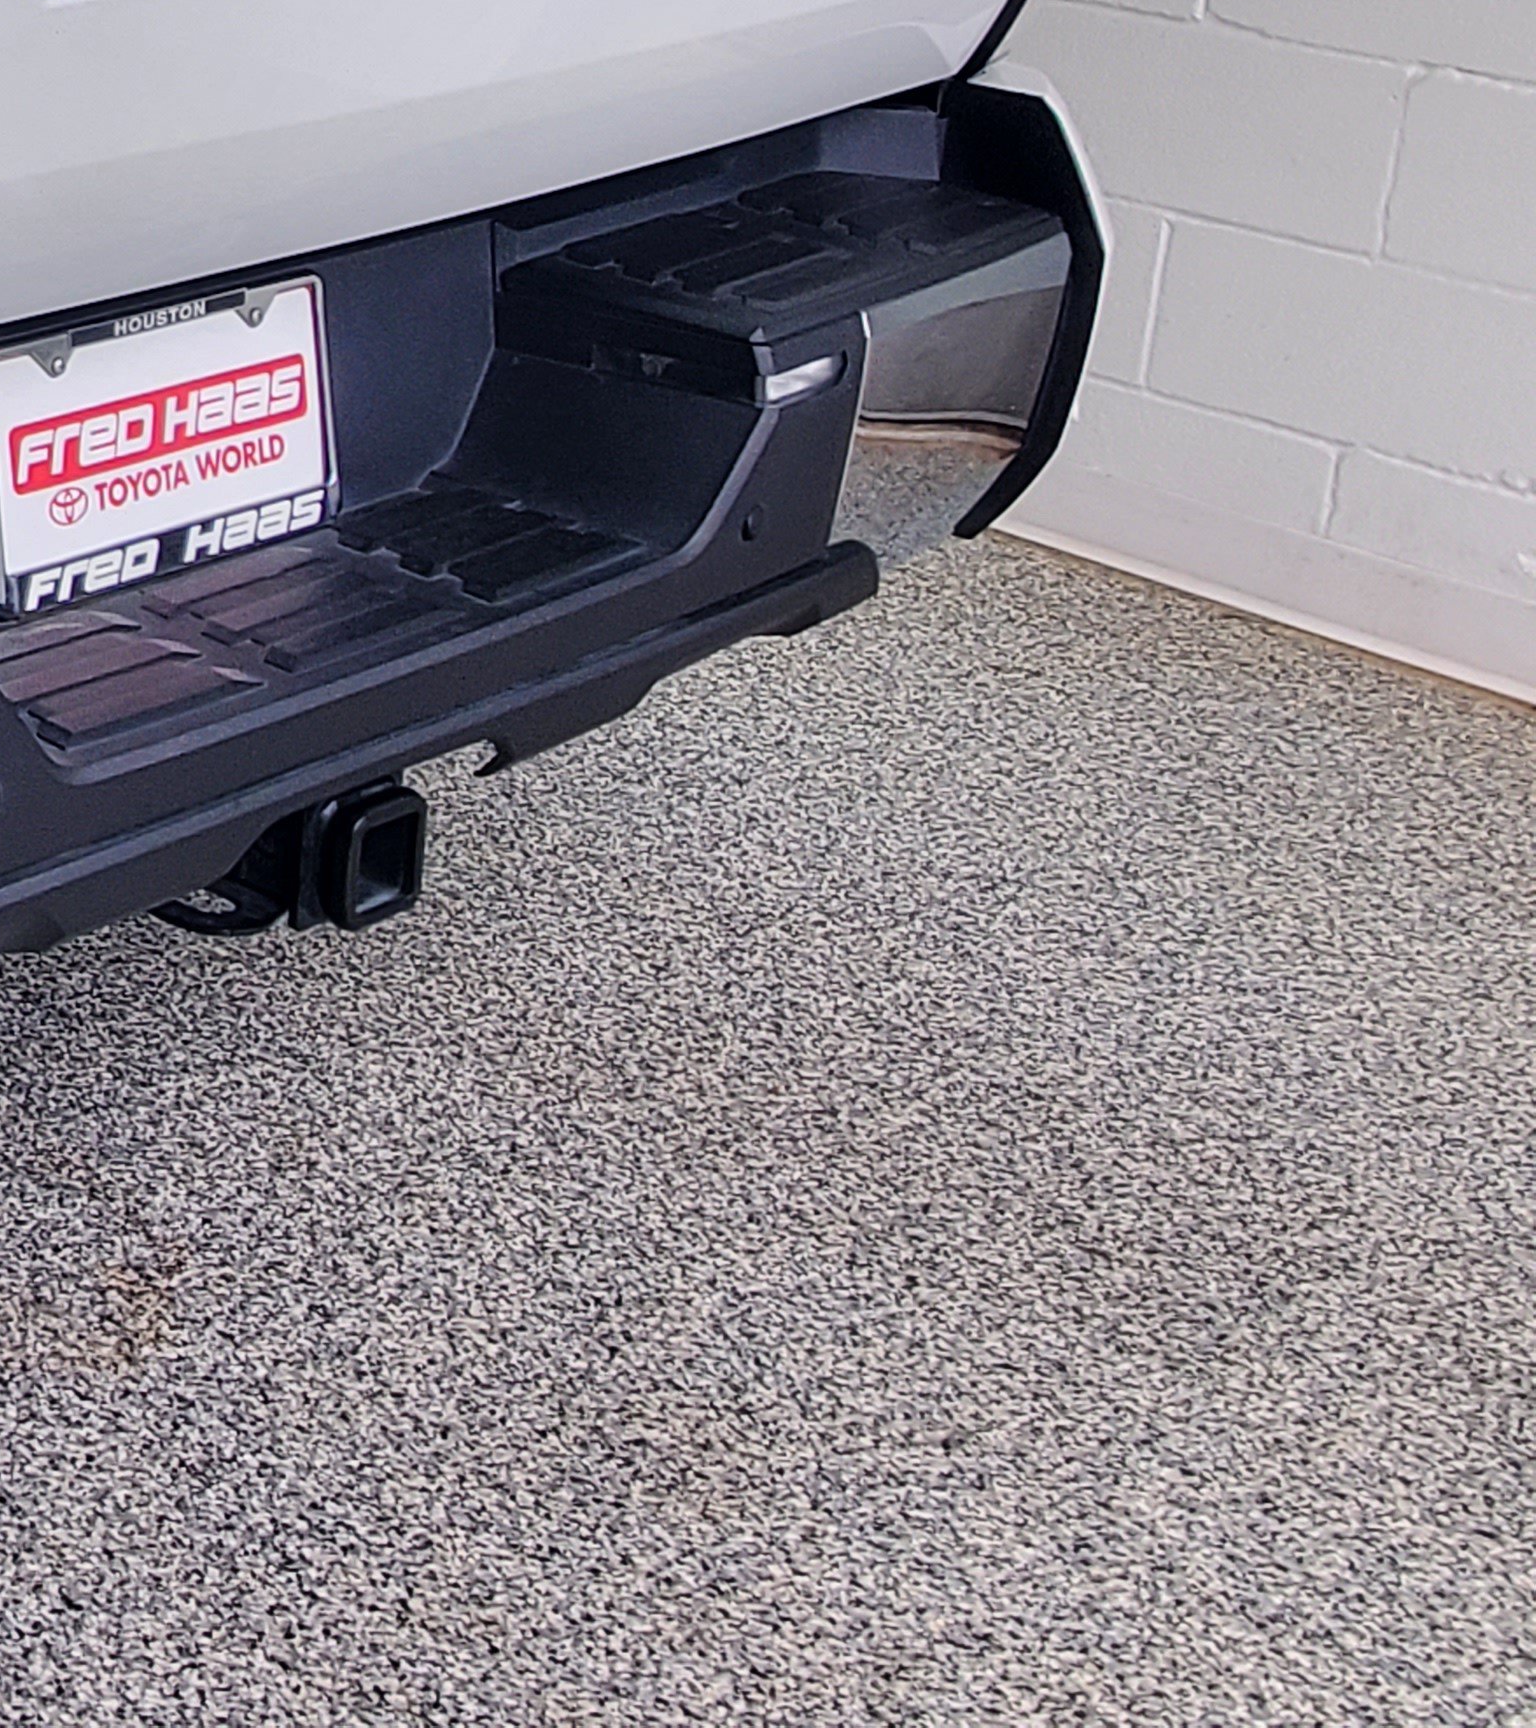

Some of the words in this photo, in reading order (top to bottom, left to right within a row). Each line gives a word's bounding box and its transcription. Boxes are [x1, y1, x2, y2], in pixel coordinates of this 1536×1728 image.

[113, 300, 207, 337] HOUSTON
[95, 459, 190, 511] TOYOTA
[196, 433, 285, 478] WORLD
